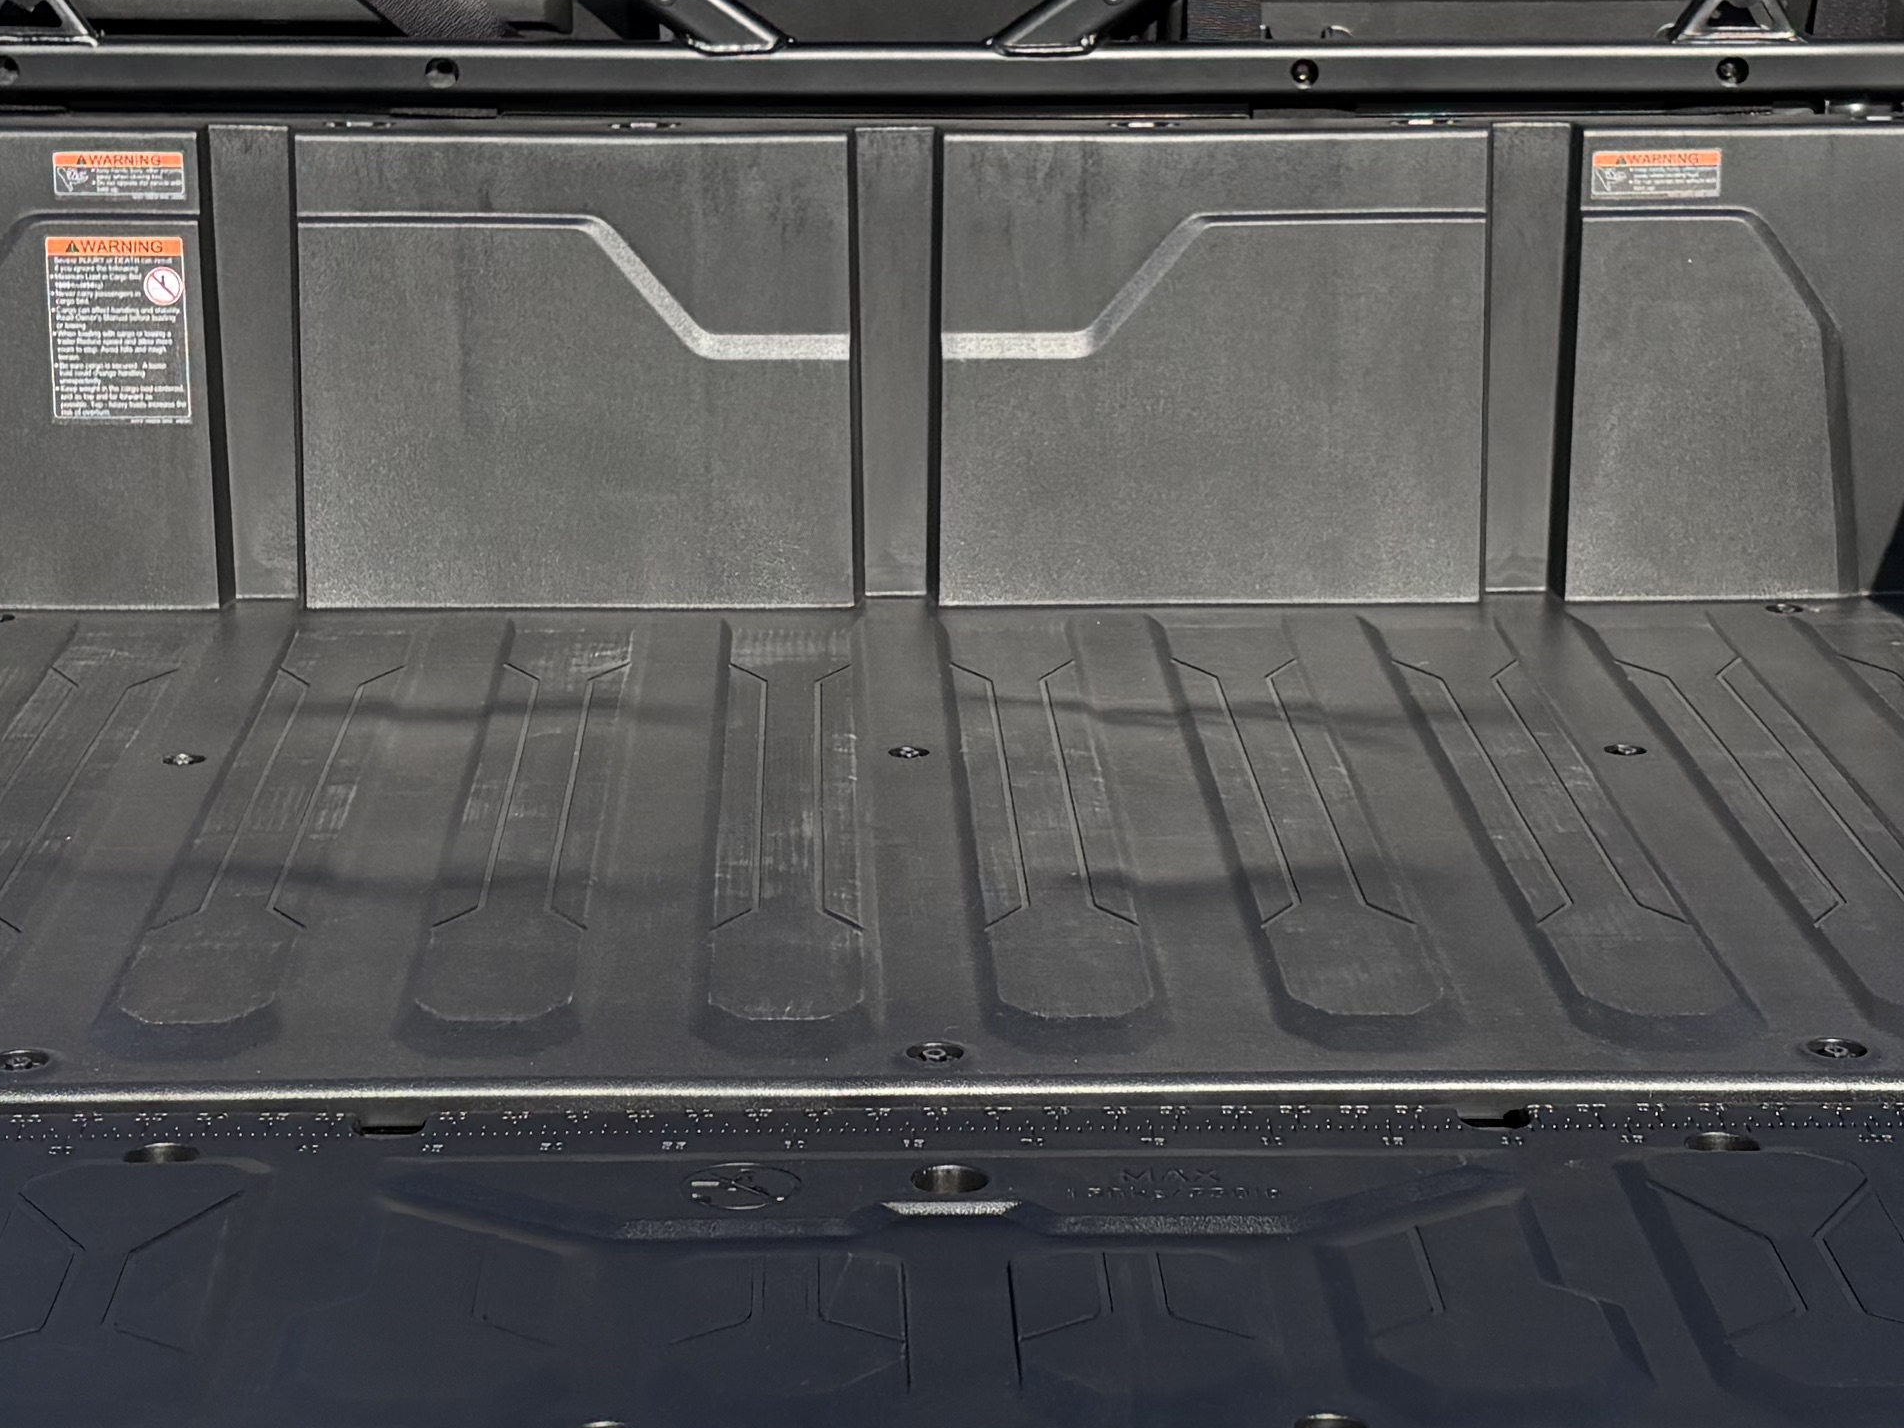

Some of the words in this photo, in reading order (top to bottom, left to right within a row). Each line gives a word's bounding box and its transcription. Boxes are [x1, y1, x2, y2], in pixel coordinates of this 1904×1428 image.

[90, 154, 162, 166] WARNING
[1628, 153, 1700, 165] WARNING
[80, 239, 163, 254] WARNING
[1121, 1168, 1221, 1182] MAX
